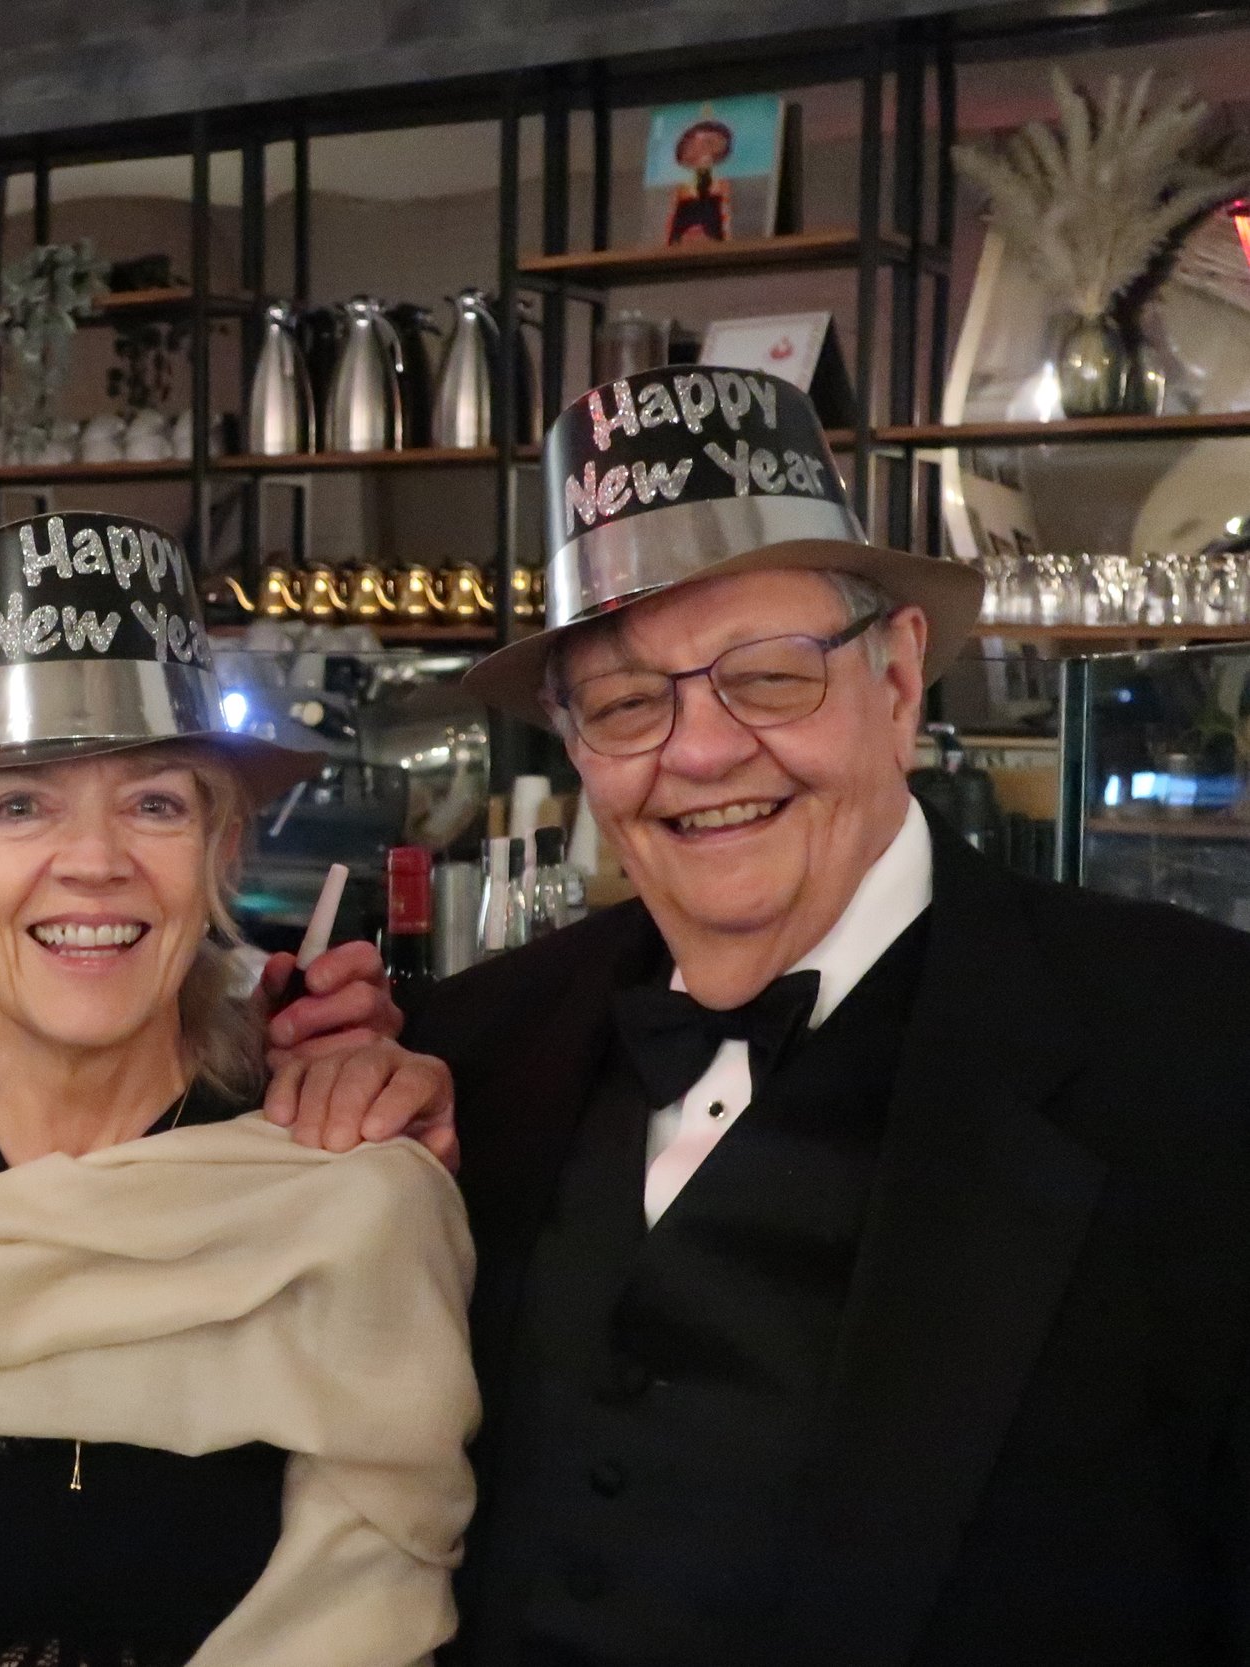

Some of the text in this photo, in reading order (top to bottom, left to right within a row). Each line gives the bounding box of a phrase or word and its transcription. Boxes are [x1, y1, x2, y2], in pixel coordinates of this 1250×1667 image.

[588, 371, 777, 451] Happy
[565, 439, 825, 535] New Year
[19, 516, 184, 596] Happy
[131, 600, 212, 668] Yea
